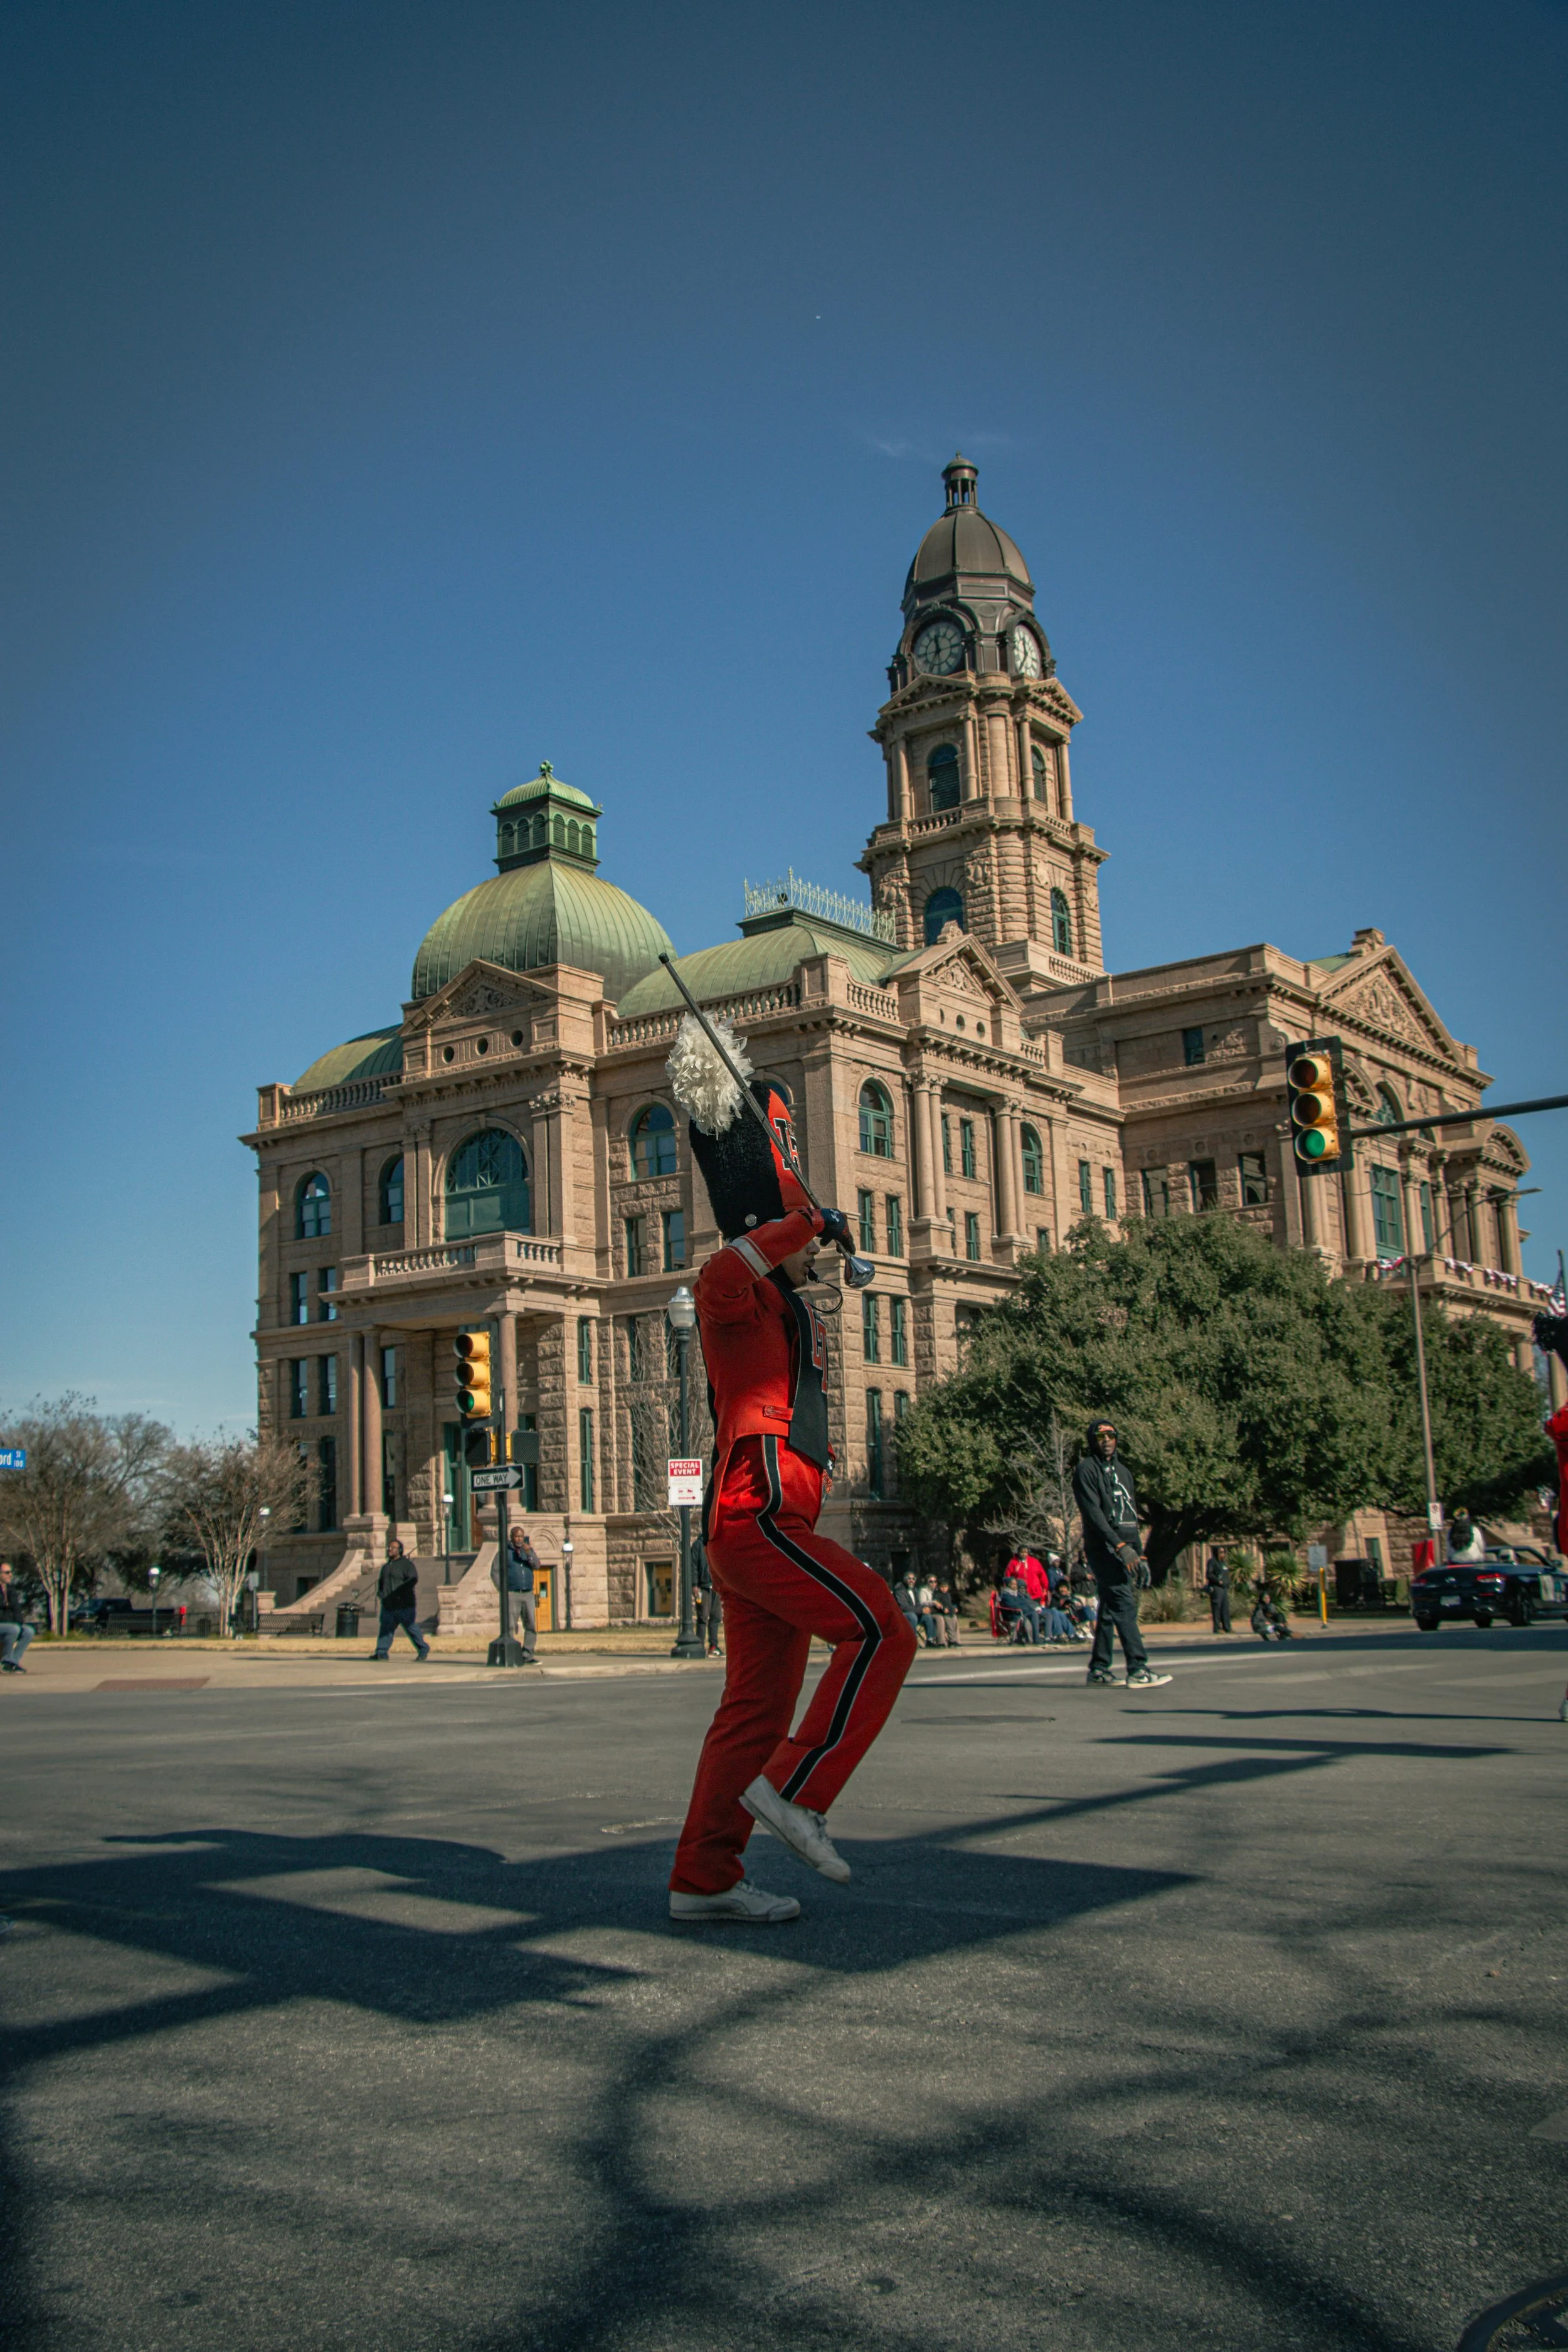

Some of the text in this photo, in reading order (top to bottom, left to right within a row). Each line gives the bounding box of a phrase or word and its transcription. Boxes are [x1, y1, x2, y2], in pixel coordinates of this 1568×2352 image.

[14, 1459, 23, 1468] 100
[475, 1474, 507, 1486] ONE WAY
